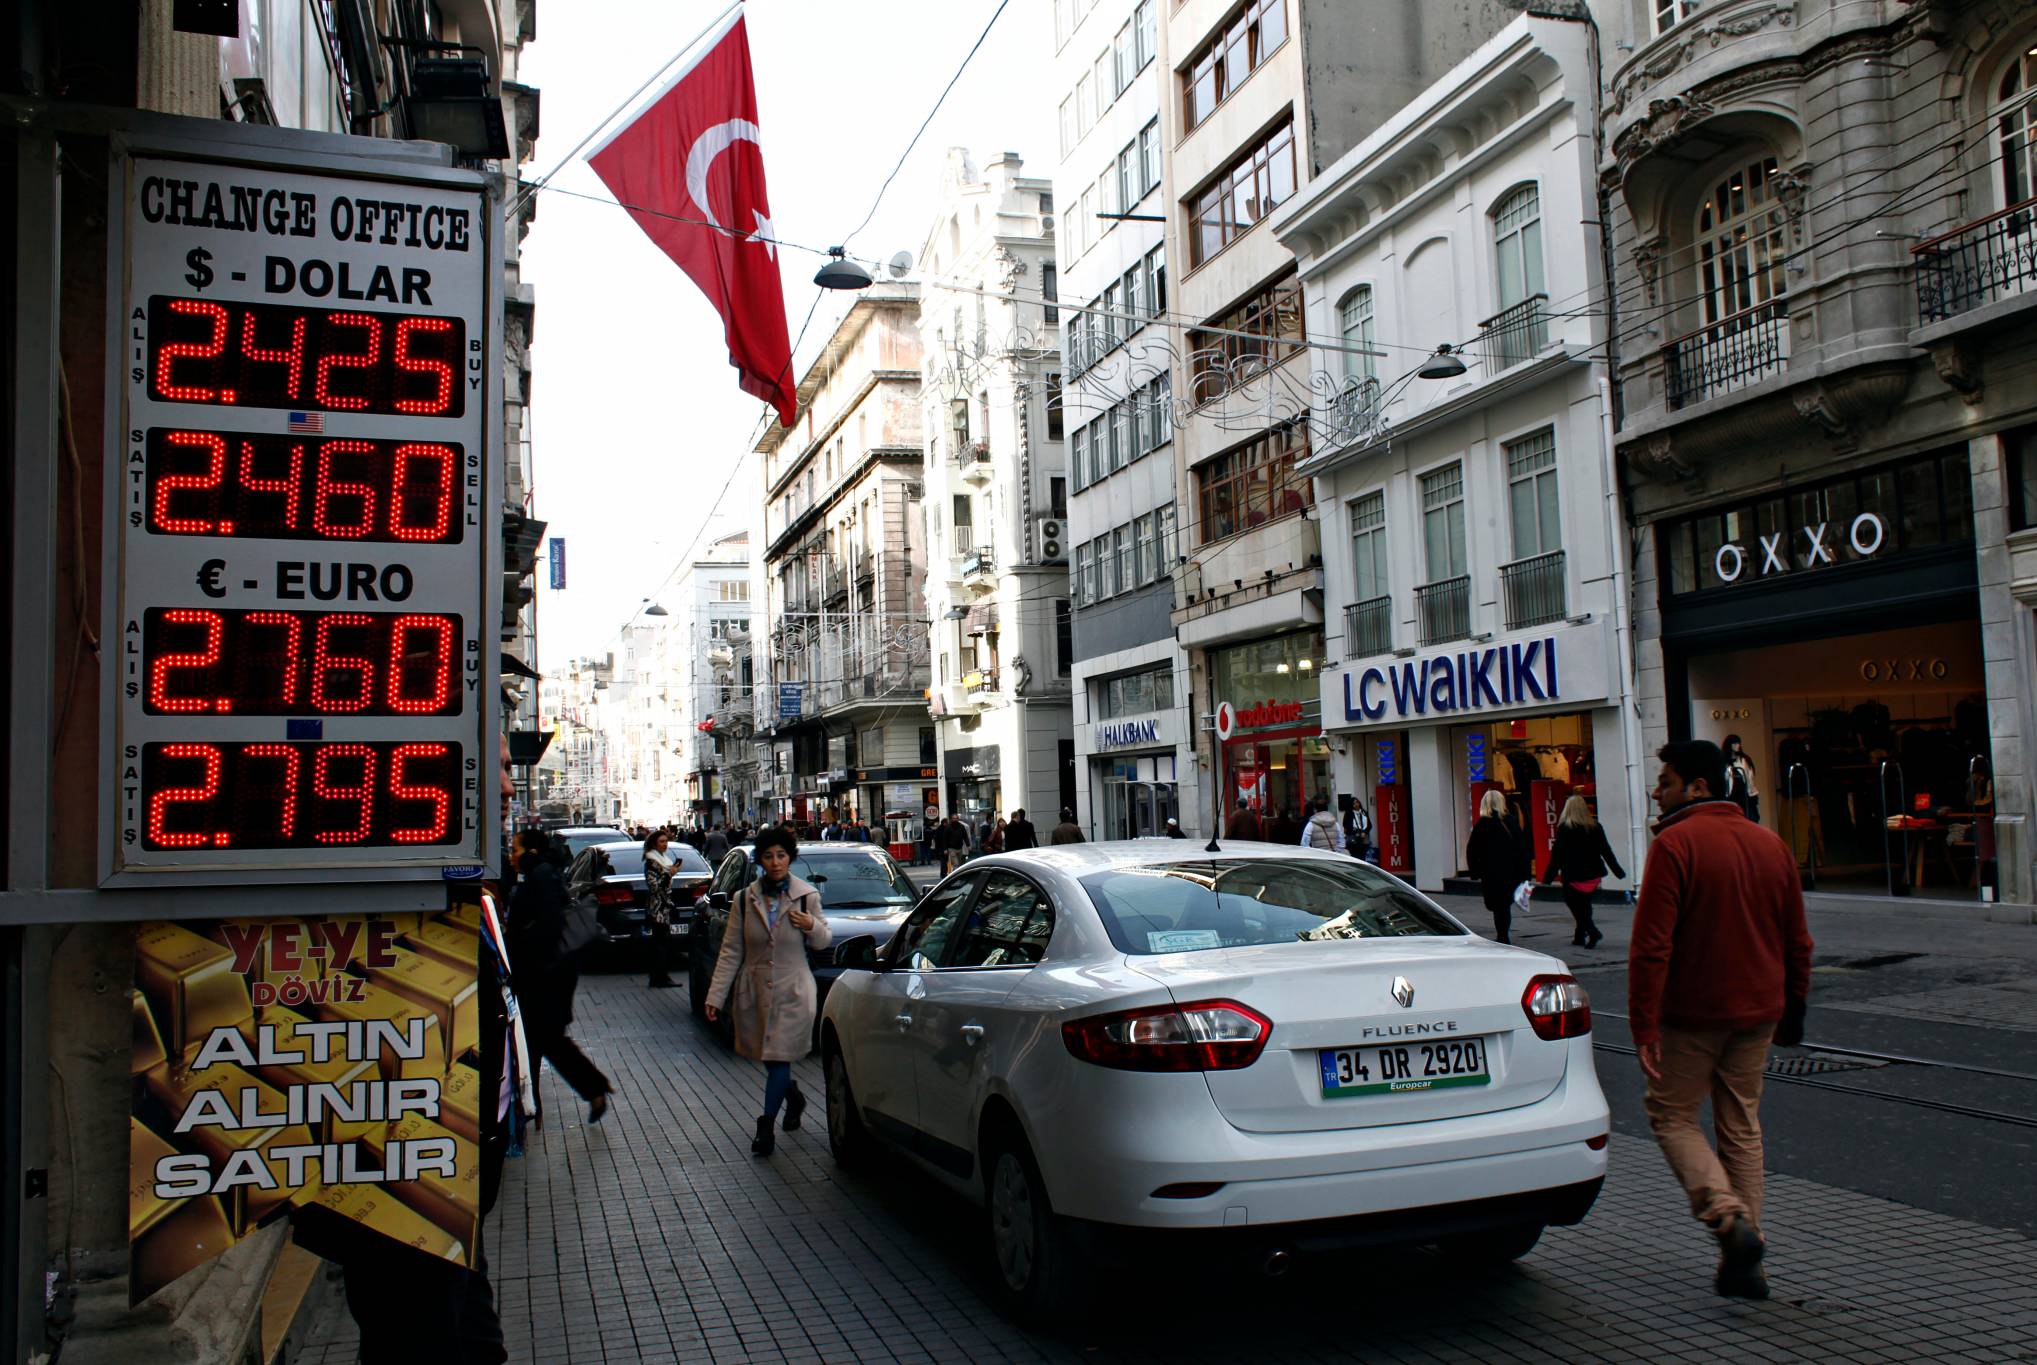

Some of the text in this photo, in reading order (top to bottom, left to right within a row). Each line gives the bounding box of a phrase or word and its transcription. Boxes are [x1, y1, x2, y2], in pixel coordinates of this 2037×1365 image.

[141, 175, 470, 252] CHANGE OFFICE
[184, 246, 214, 292] $
[264, 255, 433, 306] DOLAR
[131, 306, 146, 384] ALIŞ
[156, 300, 453, 414] 2.425
[469, 339, 482, 391] BUY
[130, 429, 145, 528] SATIŞ
[154, 431, 455, 541] 2.460
[466, 454, 479, 526] SELL
[1715, 512, 1884, 582] OXXO
[196, 558, 227, 598] €
[276, 561, 414, 602] EURO
[125, 620, 140, 699] ALIŞ
[151, 610, 454, 713] 2.760
[467, 639, 479, 692] BUY
[1860, 658, 1949, 681] OXXO
[1236, 699, 1303, 728] vodafone
[1344, 670, 1387, 722] LC
[1712, 708, 1751, 722] OXXO
[1105, 719, 1157, 747] HALKBANK
[123, 745, 138, 846] SATIŞ
[149, 744, 450, 847] 2.795
[464, 758, 477, 831] SELL
[921, 767, 938, 778] GRE
[221, 920, 399, 974] YE-YE
[252, 973, 369, 1007] DÖVİZ
[190, 1018, 426, 1071] ALTIN
[1362, 1021, 1459, 1038] FLUENCE
[1325, 1072, 1338, 1081] TR
[1336, 1042, 1479, 1083] 34 DR 2920
[1390, 1081, 1432, 1091] Europcar
[173, 1077, 441, 1134] ALINIR
[153, 1136, 458, 1200] SATILIR
